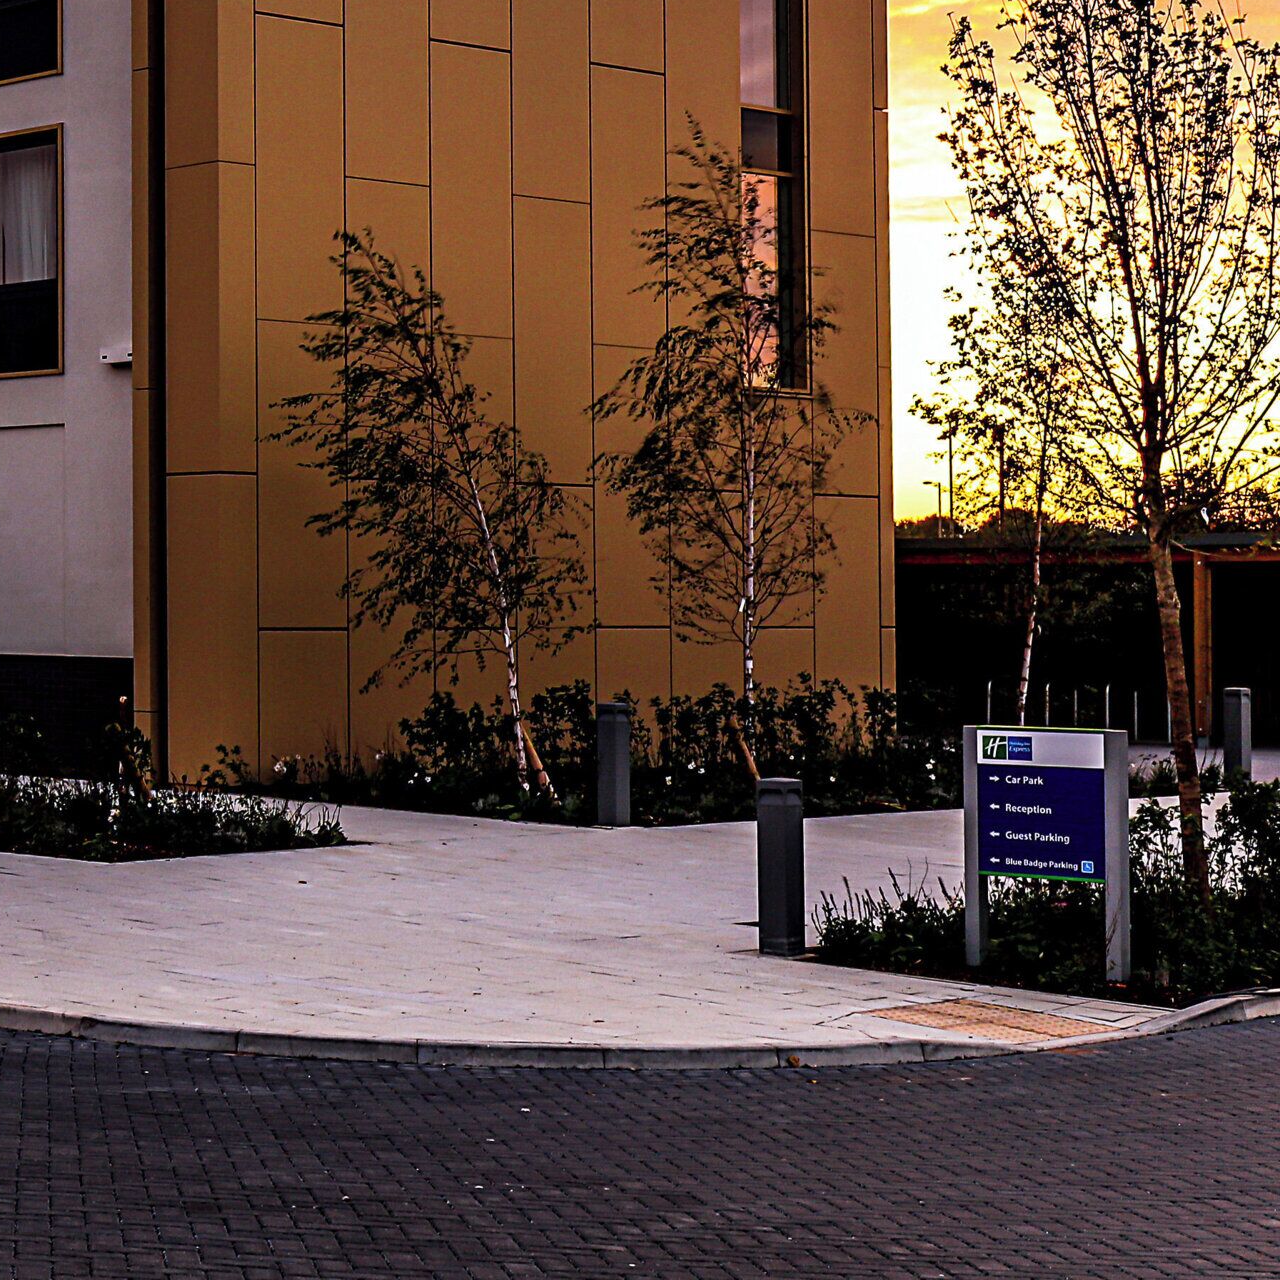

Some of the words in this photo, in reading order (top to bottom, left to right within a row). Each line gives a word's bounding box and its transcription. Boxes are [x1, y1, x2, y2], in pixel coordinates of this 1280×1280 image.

[1005, 775, 1021, 784] Car
[1023, 776, 1044, 785] Park
[1005, 803, 1052, 815] Reception
[1005, 831, 1032, 840] Guest
[1034, 832, 1070, 845] Parking
[1005, 857, 1022, 866] Blue
[1024, 858, 1048, 869] Badge
[1049, 860, 1078, 871] Parking
